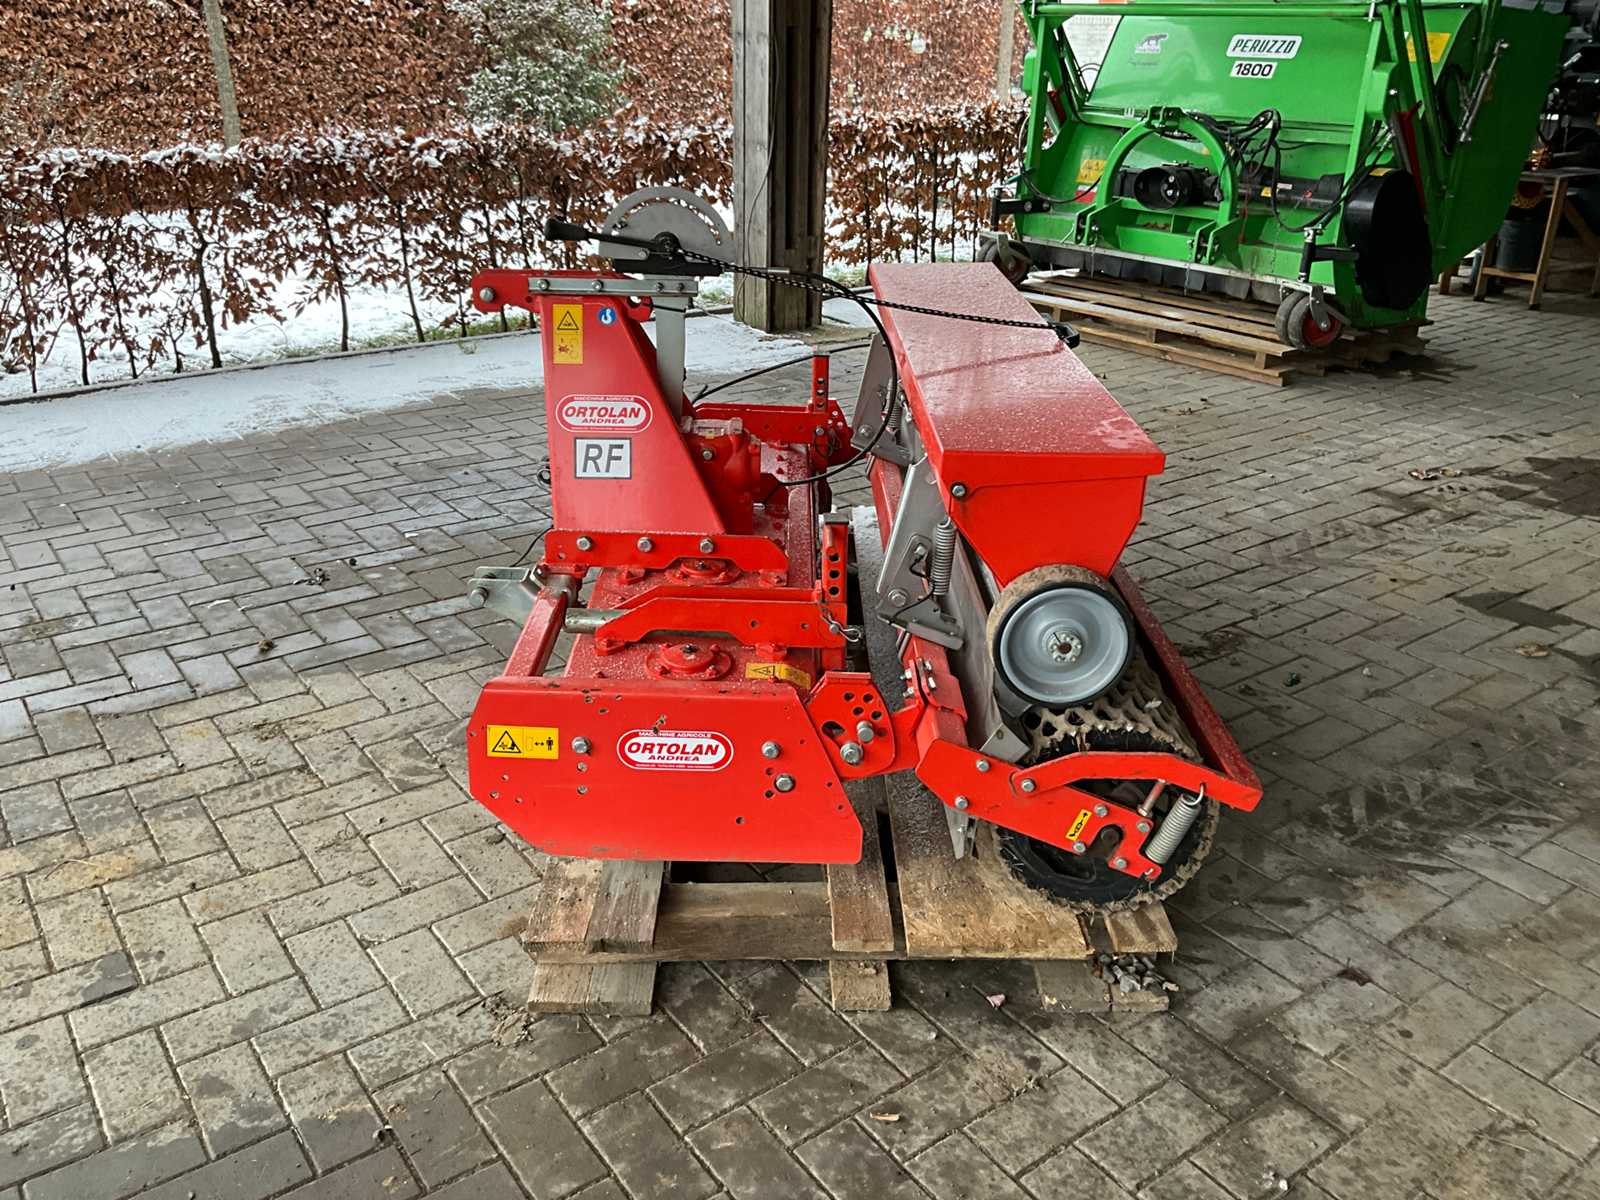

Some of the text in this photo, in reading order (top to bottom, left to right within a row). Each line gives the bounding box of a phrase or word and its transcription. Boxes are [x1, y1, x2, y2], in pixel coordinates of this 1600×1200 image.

[1231, 38, 1297, 54] PERUZZO
[1234, 62, 1274, 77] 1800
[564, 405, 642, 418] ORTOLAN
[582, 443, 625, 473] RF
[627, 742, 720, 756] ORTOLAN
[648, 754, 700, 762] ANDREA
